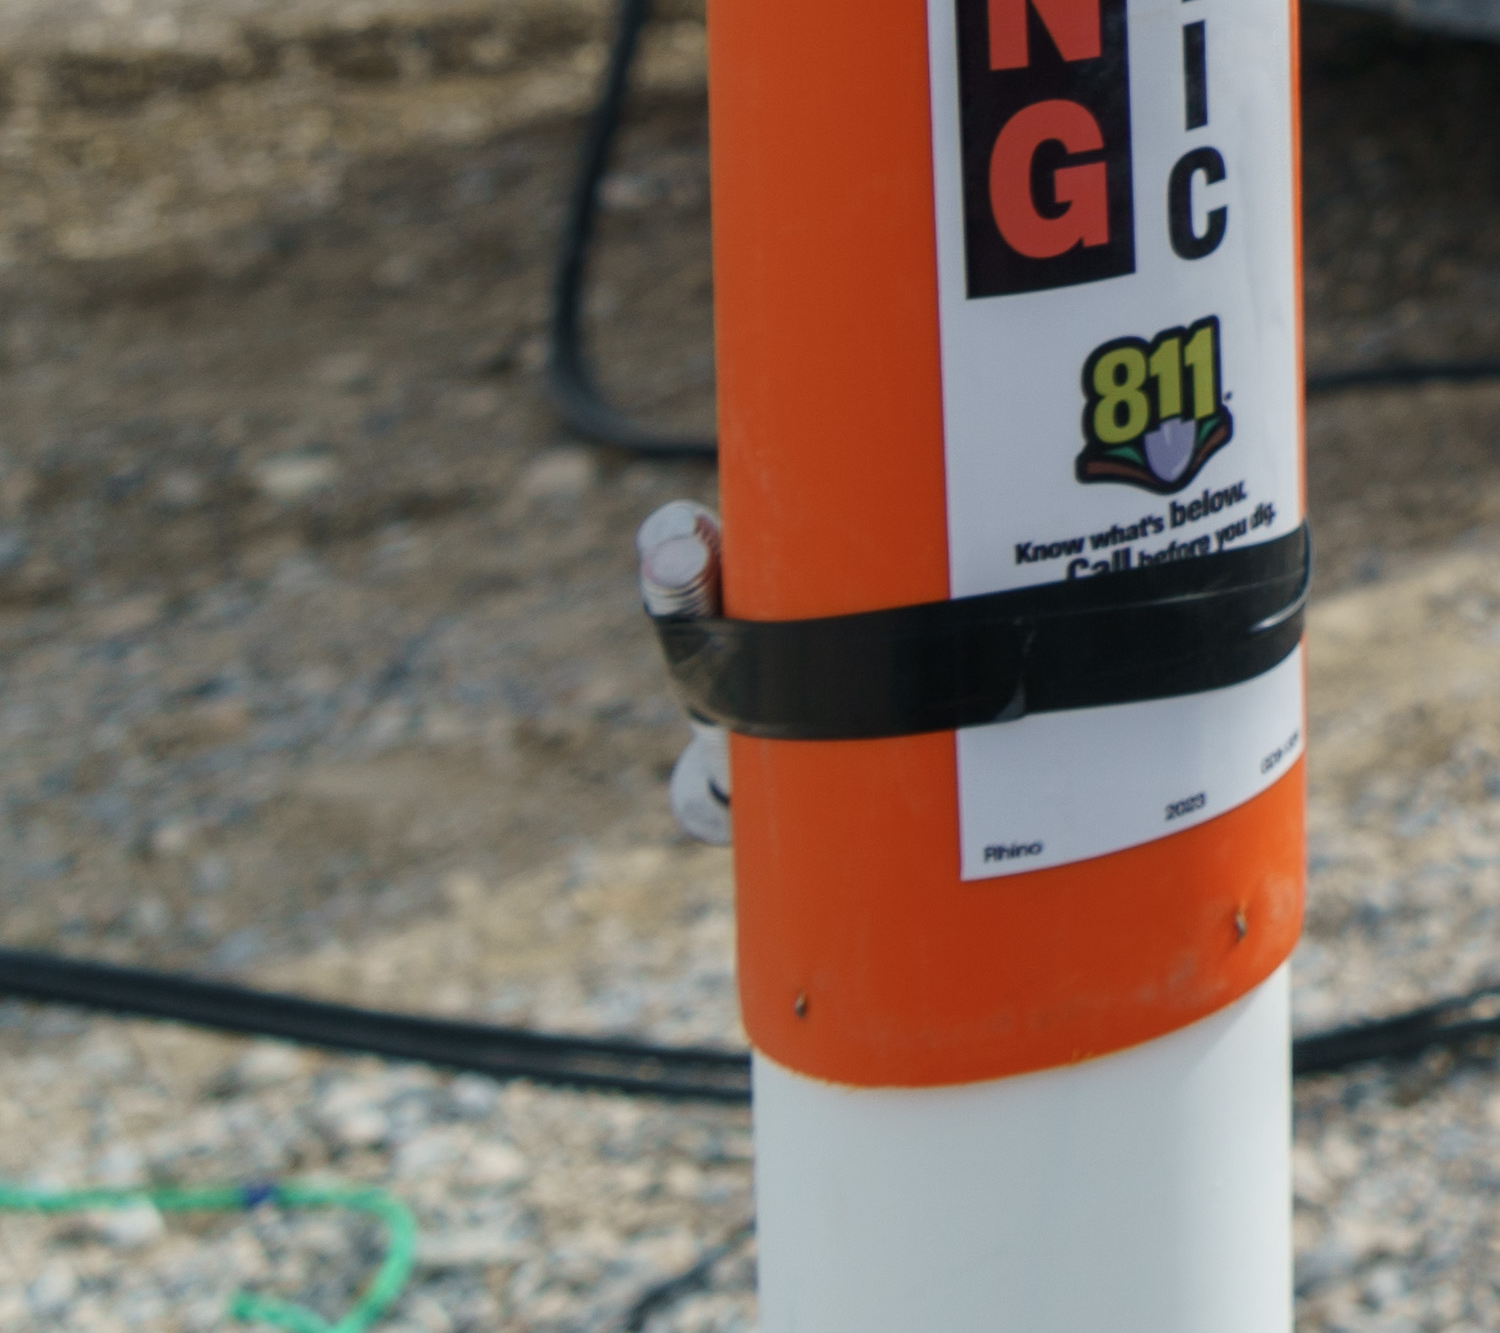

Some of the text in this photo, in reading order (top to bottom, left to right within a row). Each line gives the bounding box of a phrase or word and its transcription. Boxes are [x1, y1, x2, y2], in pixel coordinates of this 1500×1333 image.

[1092, 325, 1216, 445] 811
[1015, 536, 1085, 565] Know
[1090, 515, 1165, 549] what's
[1215, 517, 1248, 551] you
[983, 842, 1043, 864] Rhino
